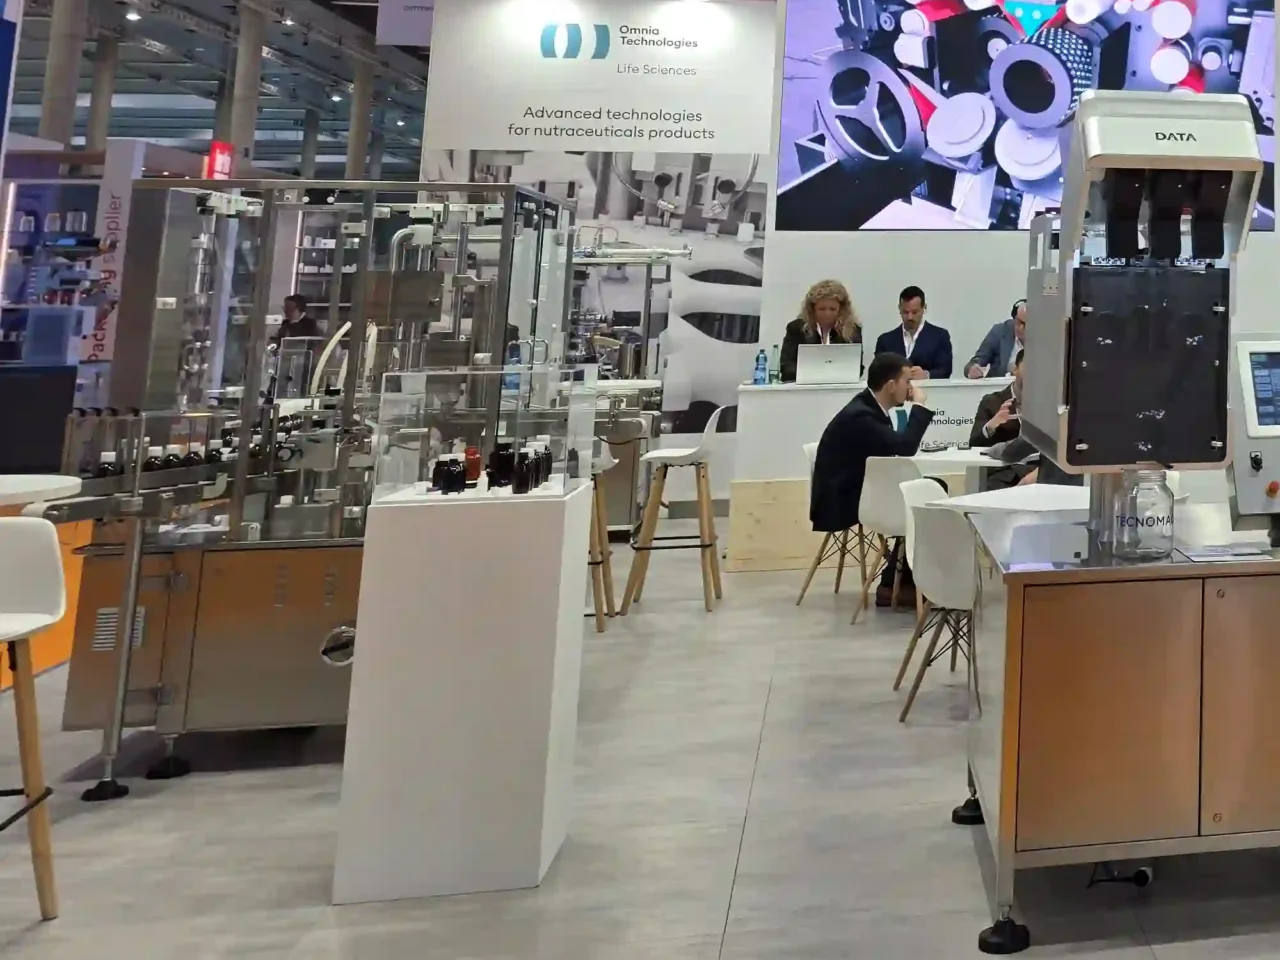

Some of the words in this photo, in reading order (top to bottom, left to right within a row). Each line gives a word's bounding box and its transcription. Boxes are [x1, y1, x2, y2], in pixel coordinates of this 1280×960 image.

[619, 25, 660, 36] Omnia
[620, 36, 698, 49] Technologies
[617, 63, 640, 75] Life
[643, 64, 697, 76] Sciences
[523, 106, 602, 120] Advanced
[606, 108, 703, 124] technologies
[508, 123, 531, 136] for
[534, 125, 645, 138] nutraceuticals
[648, 127, 715, 140] products
[1155, 132, 1197, 142] DATA
[101, 192, 123, 263] spplier
[930, 417, 974, 426] hnologies
[1115, 514, 1174, 528] TECNOMA
